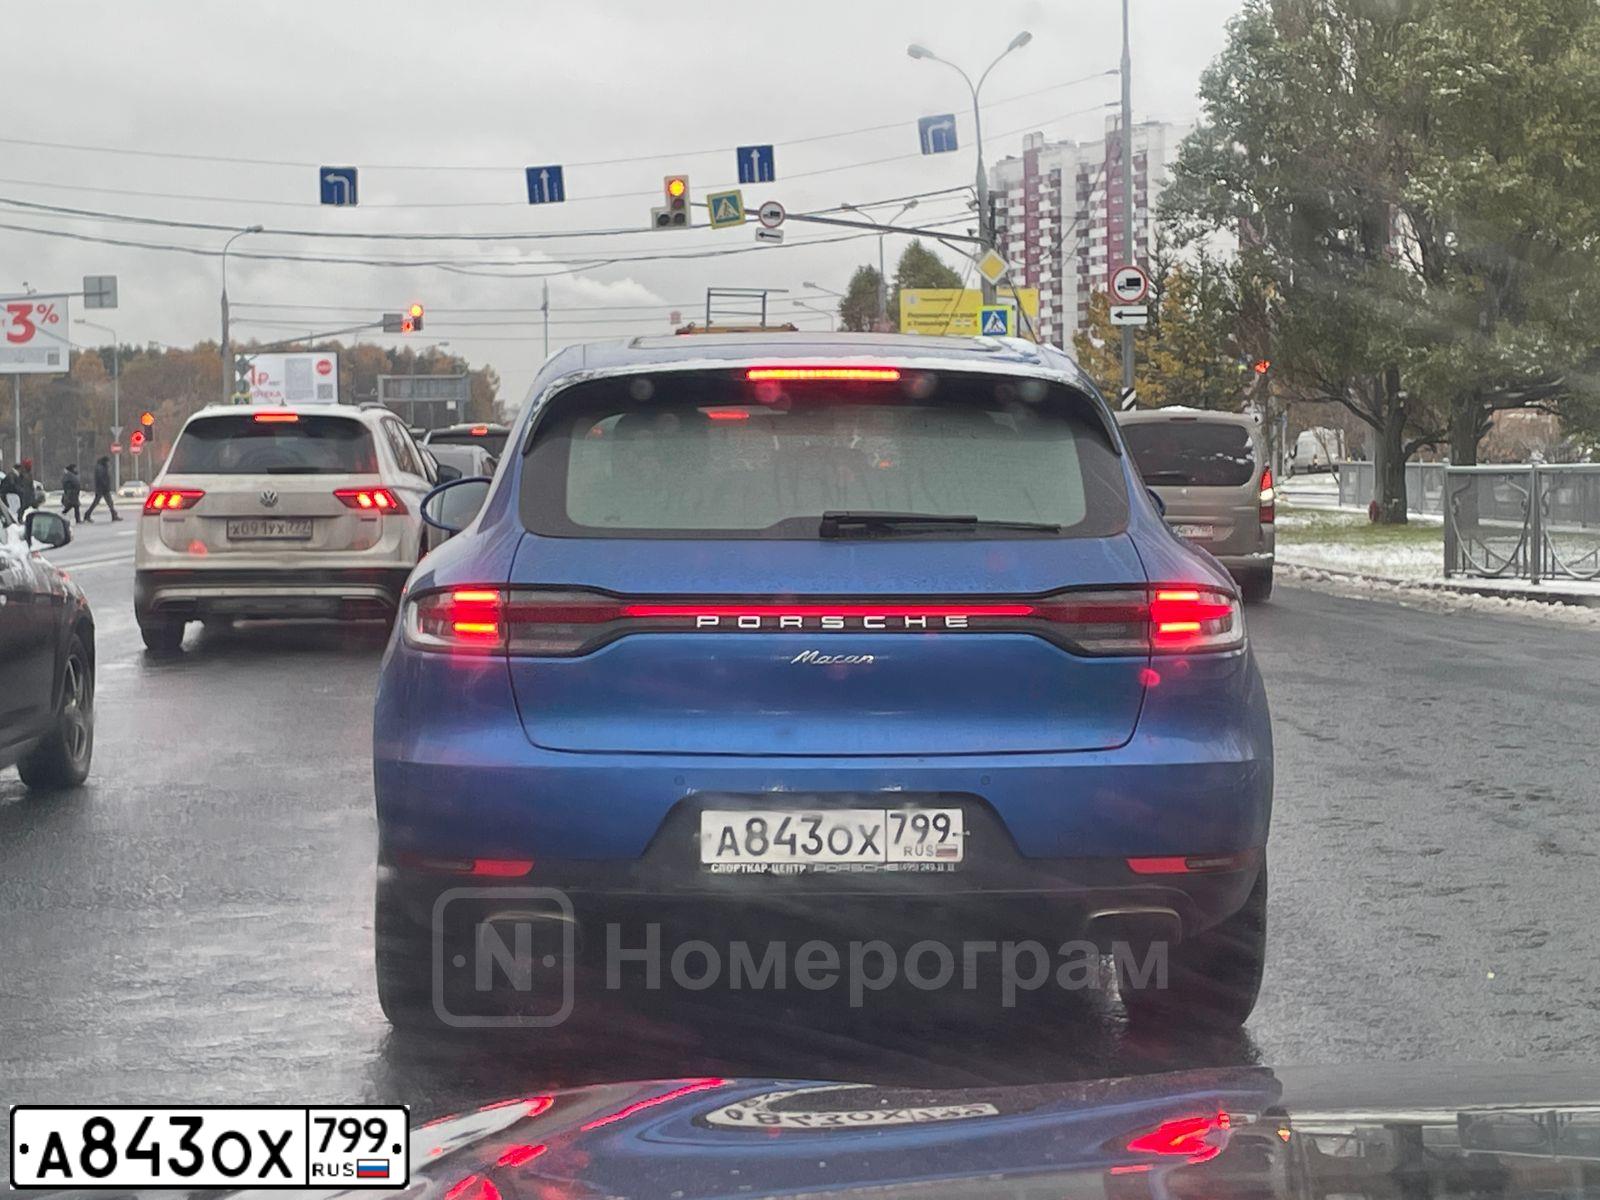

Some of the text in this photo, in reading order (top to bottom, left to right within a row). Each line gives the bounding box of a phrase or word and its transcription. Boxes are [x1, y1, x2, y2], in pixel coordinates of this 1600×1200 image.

[6, 303, 60, 345] 3%
[696, 615, 969, 629] PORSCHE
[790, 649, 876, 665] Macan
[715, 813, 951, 856] А843ОХ 799
[903, 844, 934, 857] RUS
